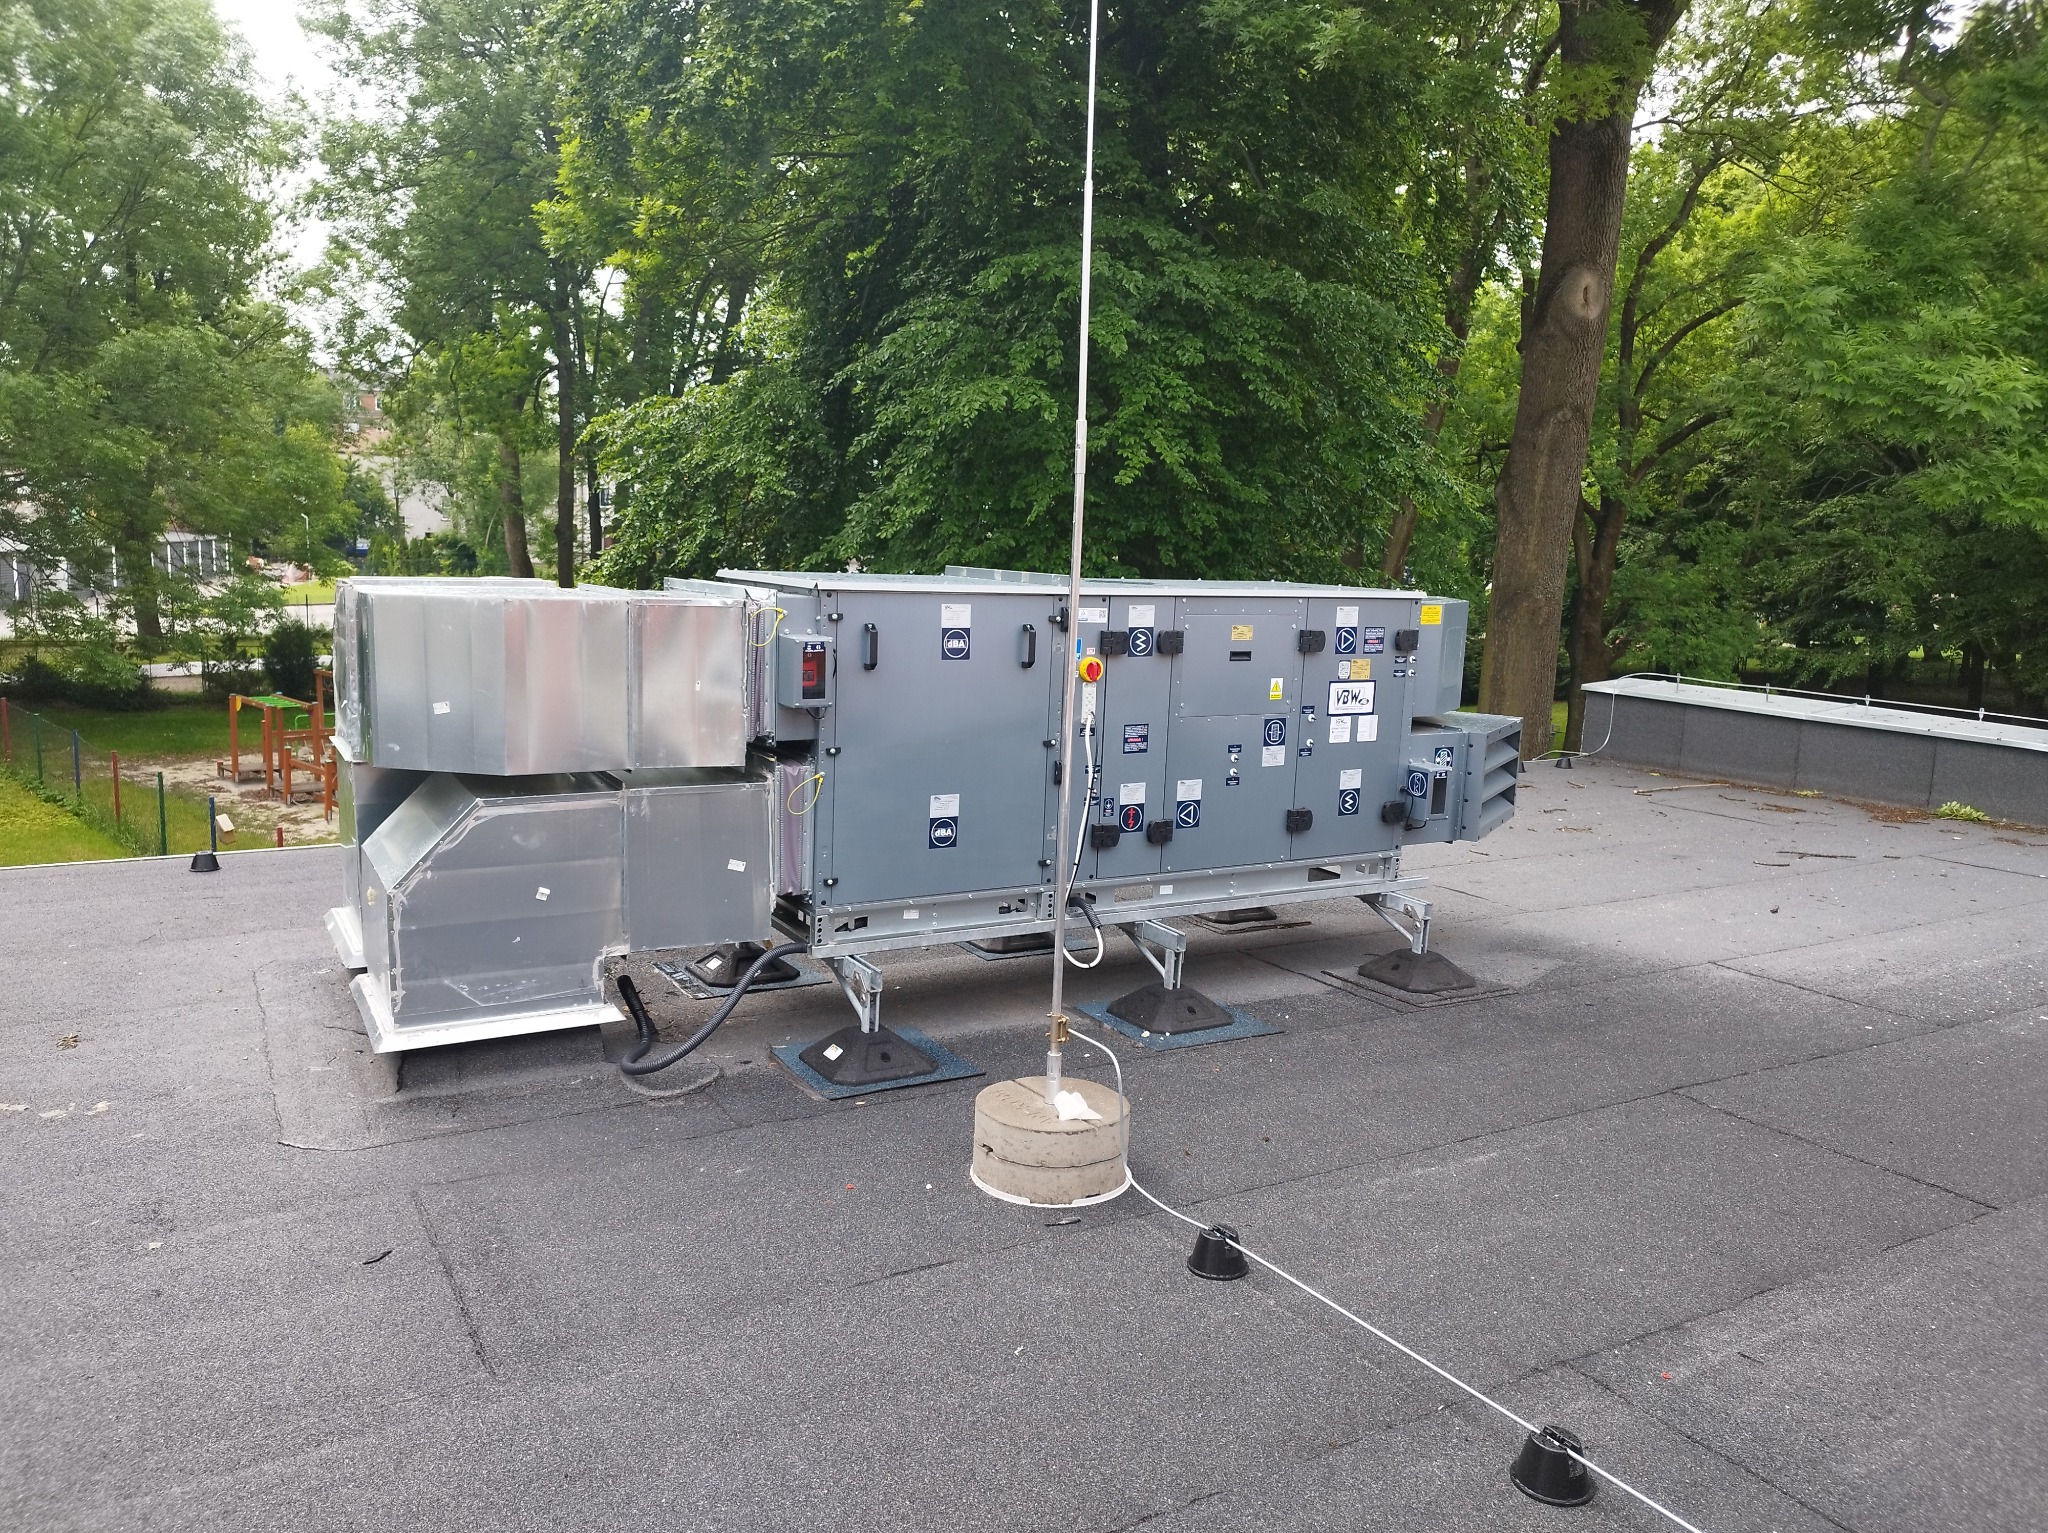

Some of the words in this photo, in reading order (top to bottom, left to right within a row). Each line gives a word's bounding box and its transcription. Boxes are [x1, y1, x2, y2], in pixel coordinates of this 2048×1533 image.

[947, 639, 966, 648] dBA
[1336, 689, 1361, 706] VBW
[934, 828, 952, 837] dBA
